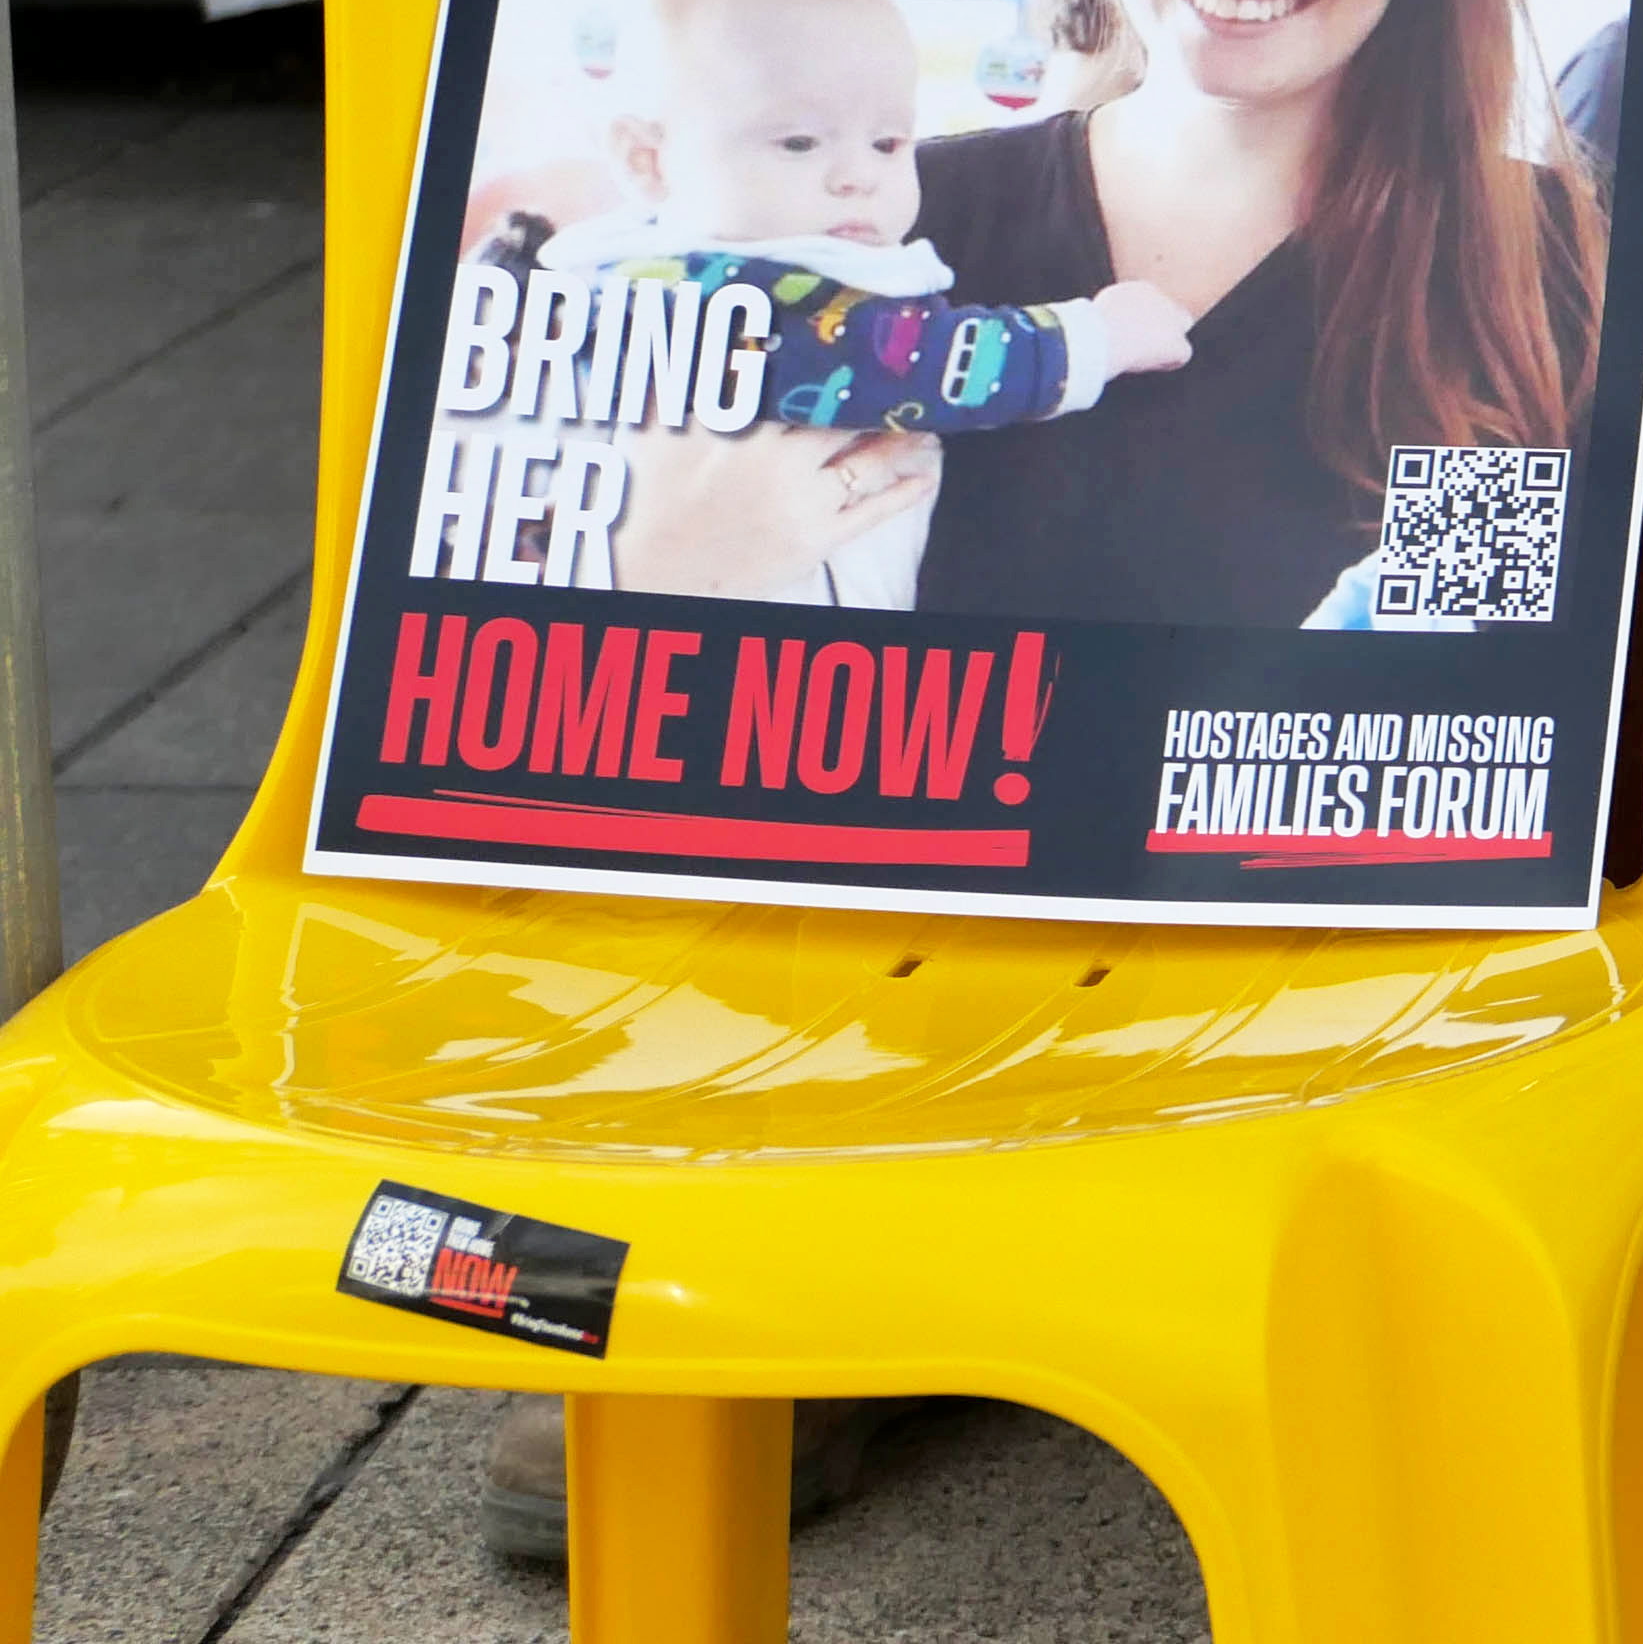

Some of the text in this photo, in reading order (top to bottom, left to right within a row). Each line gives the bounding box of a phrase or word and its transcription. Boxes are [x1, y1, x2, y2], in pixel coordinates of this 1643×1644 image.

[438, 262, 773, 433] BRING
[408, 430, 629, 592] HER
[379, 611, 1060, 806] HOME NOW!
[1162, 709, 1555, 765] HOSTAGES AND MISSING
[1154, 762, 1550, 841] FAMILIES FORUM
[431, 1246, 520, 1309] NOW
